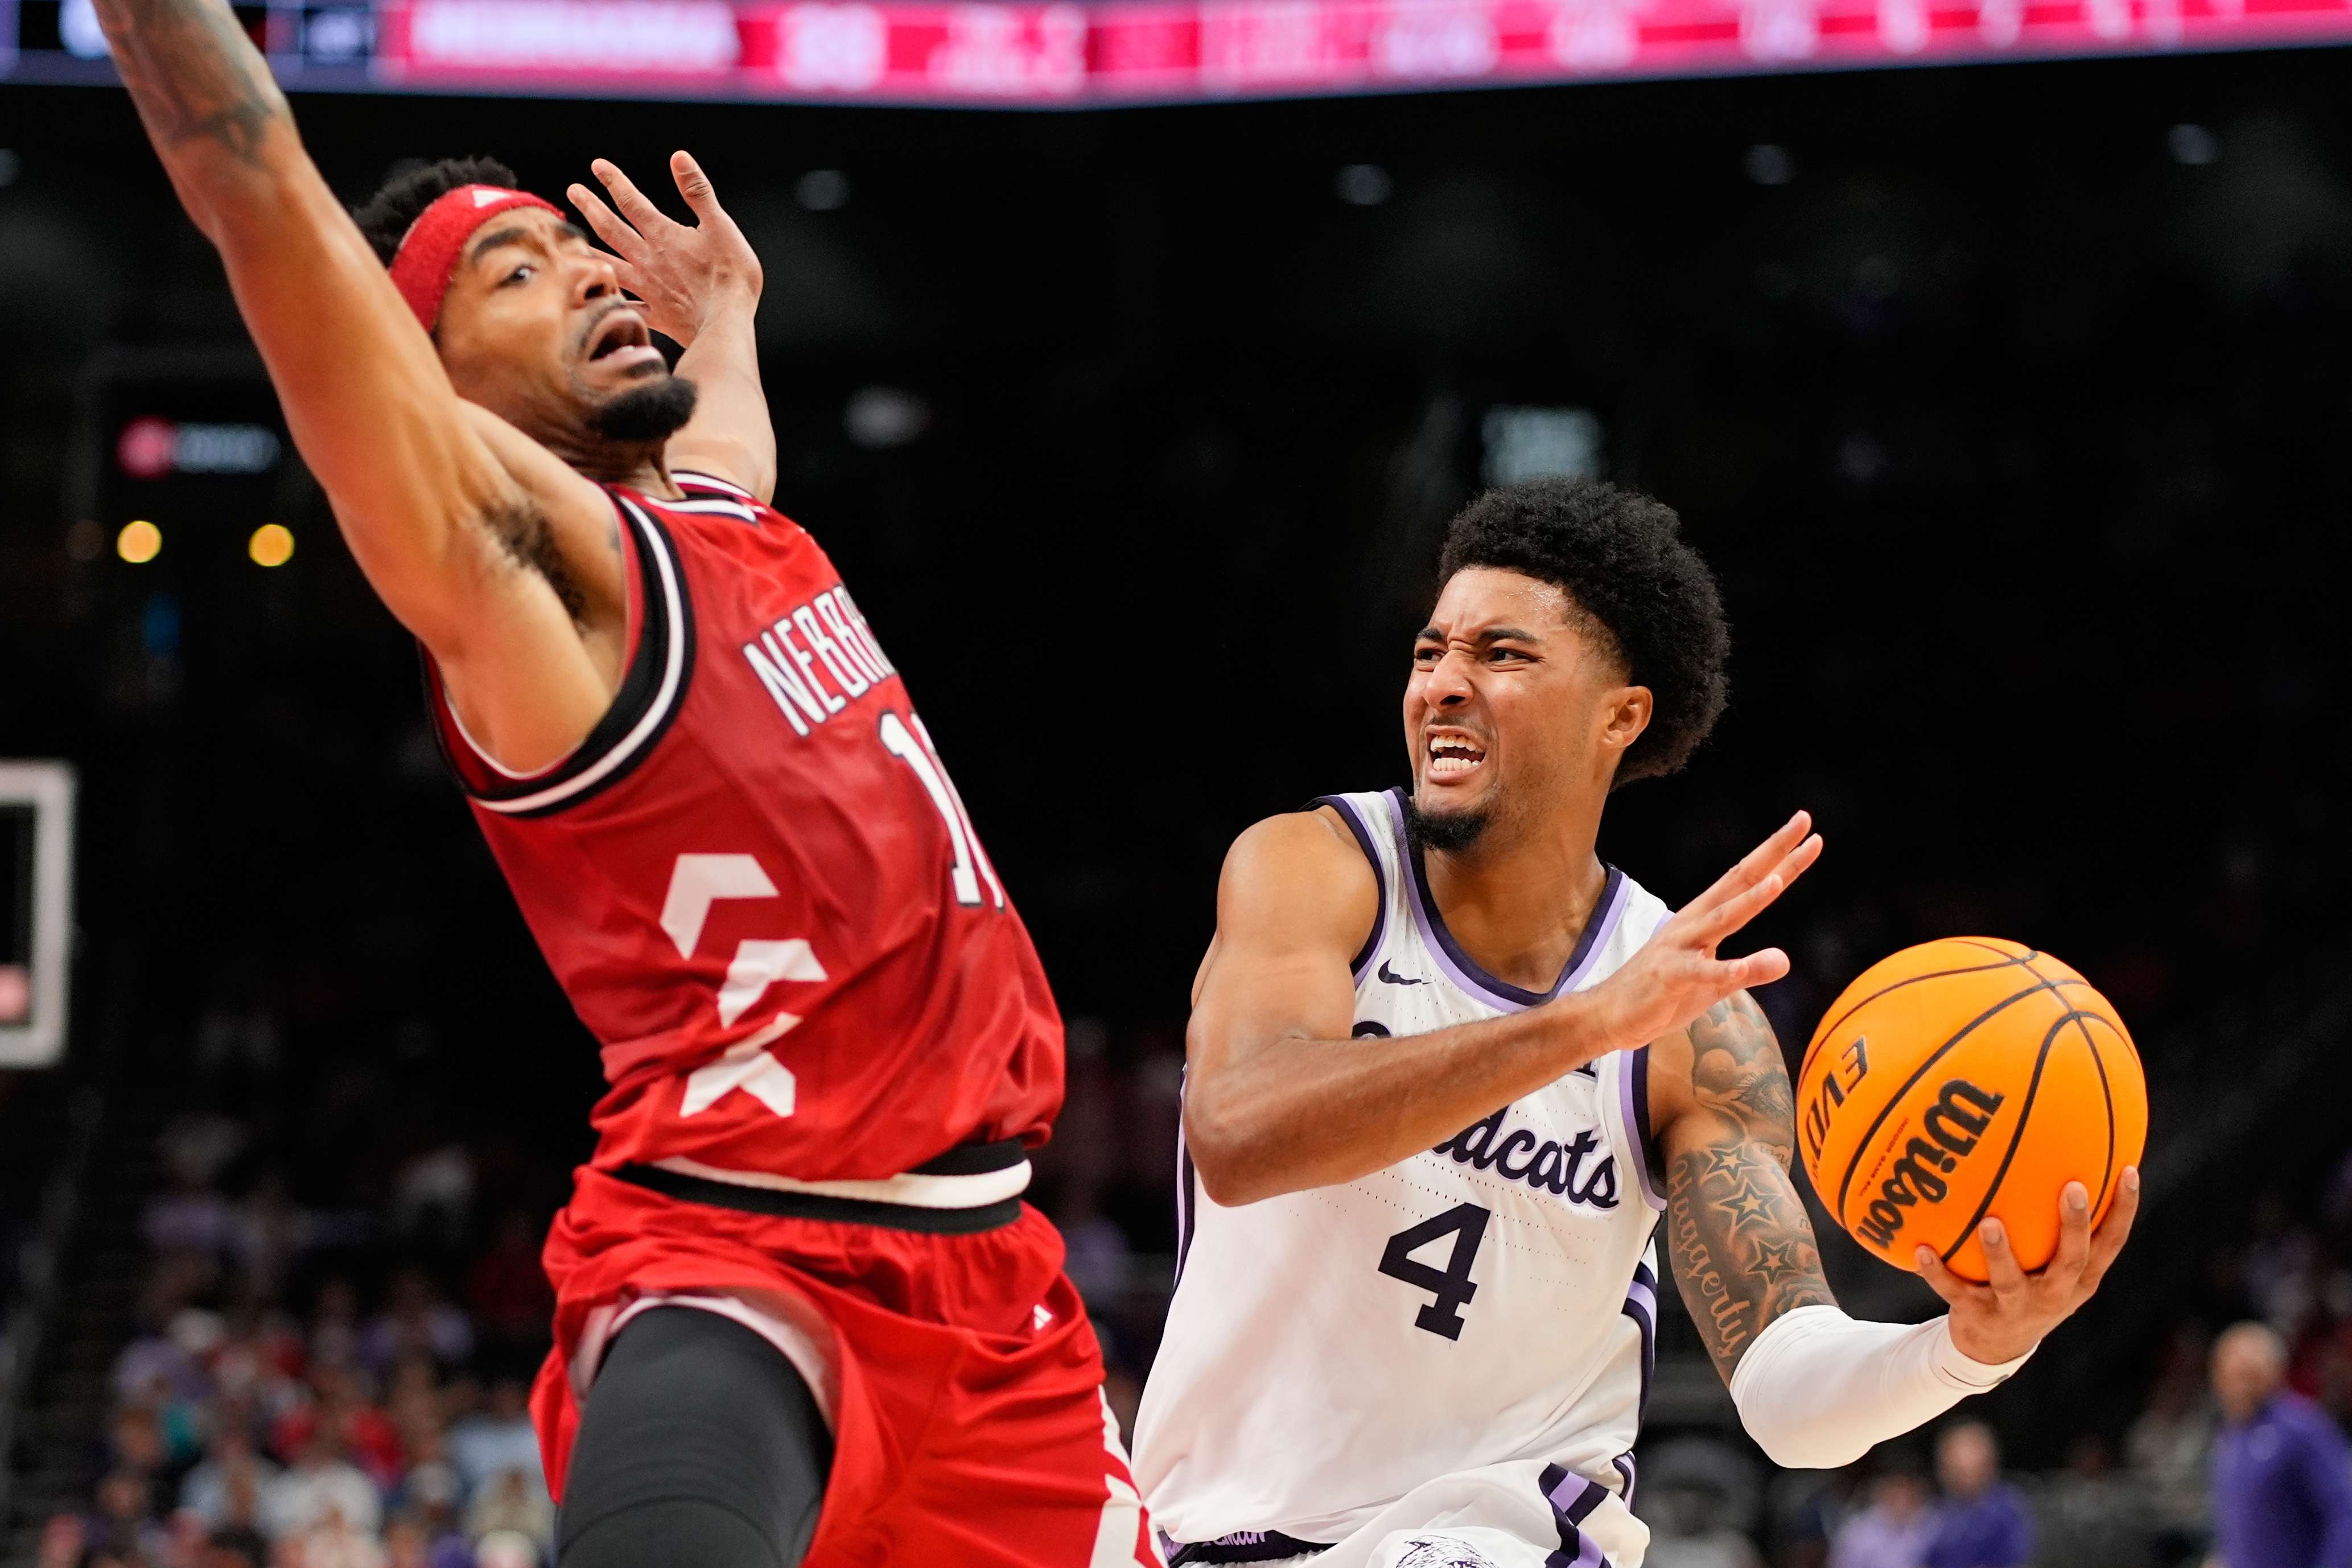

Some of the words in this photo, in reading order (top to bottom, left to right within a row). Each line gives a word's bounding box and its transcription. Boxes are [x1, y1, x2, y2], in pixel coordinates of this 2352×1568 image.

[1430, 1103, 1620, 1211] dcats
[1805, 1034, 1868, 1162] EVO
[1856, 1079, 2005, 1249] Wilson
[1378, 1202, 1491, 1342] 4
[1669, 1160, 1750, 1359] Haggerty
